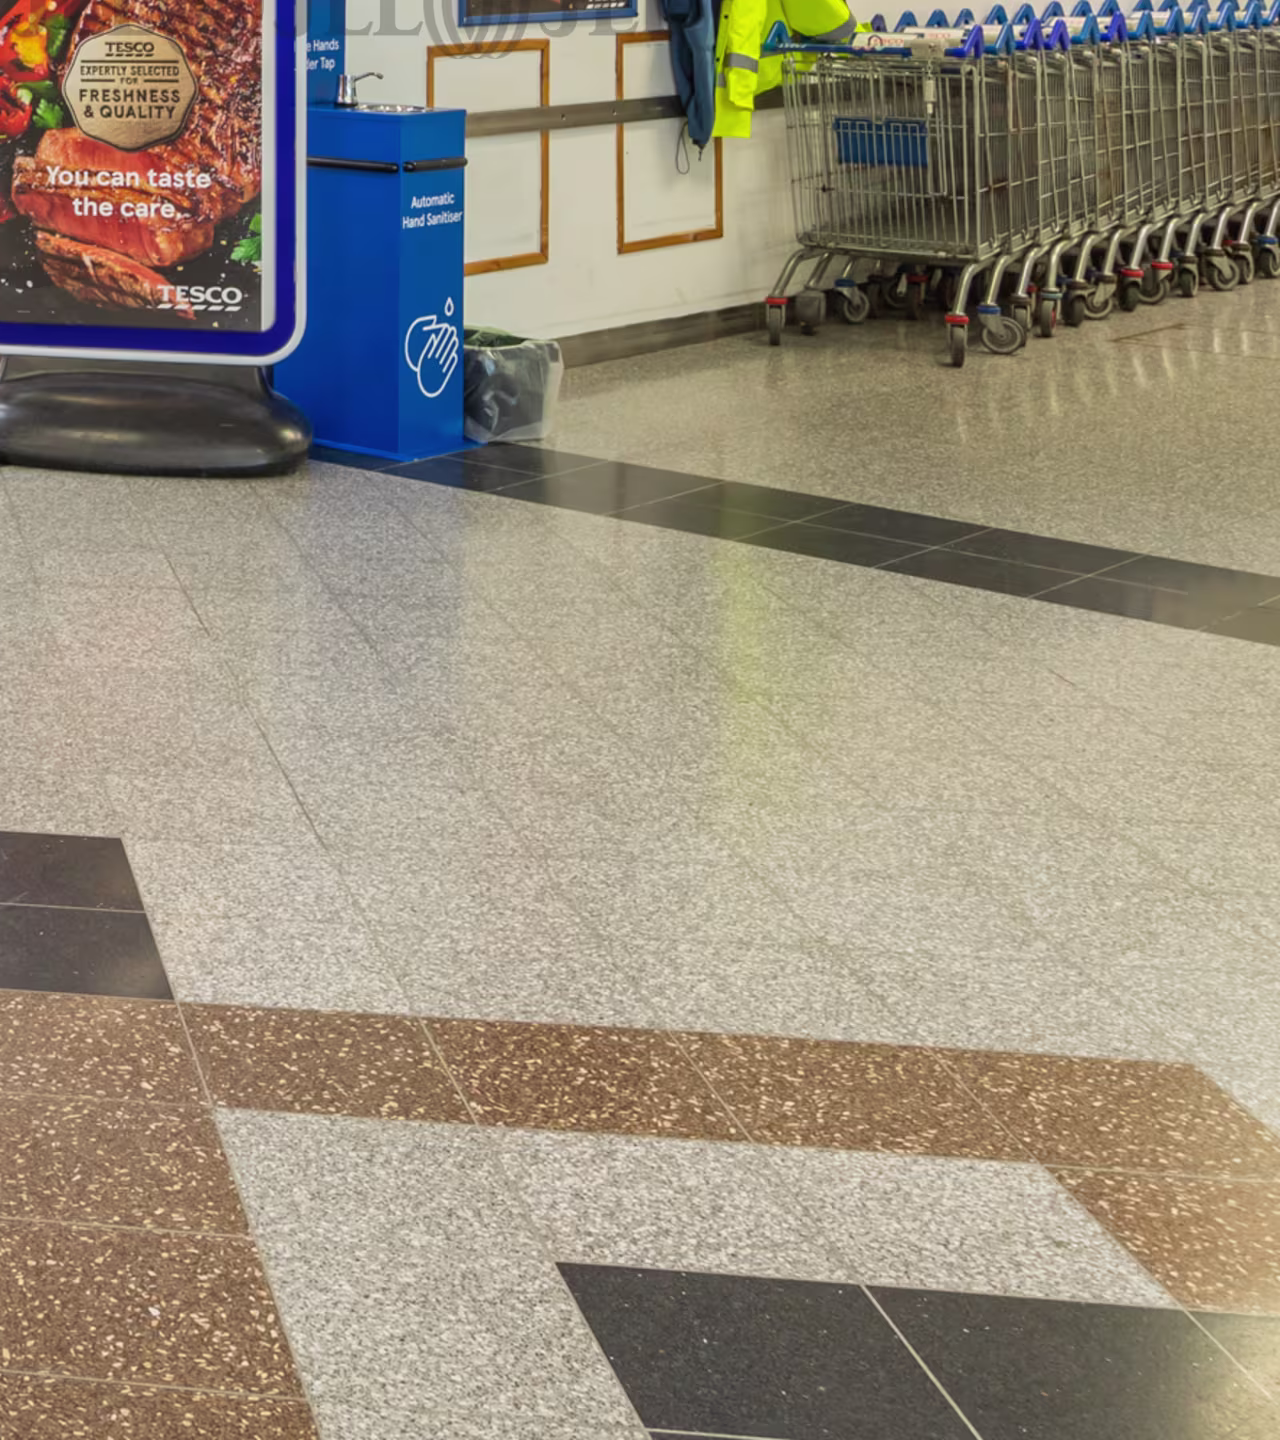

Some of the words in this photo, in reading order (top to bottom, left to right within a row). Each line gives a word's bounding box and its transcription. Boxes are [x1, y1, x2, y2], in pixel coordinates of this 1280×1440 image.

[105, 42, 154, 53] TESCO
[313, 38, 340, 52] Hands
[80, 66, 127, 77] EXPERTLY
[130, 66, 179, 77] SELECTED
[320, 56, 336, 73] Tap
[120, 77, 139, 85] FOR
[79, 88, 181, 103] FRESHNESS
[83, 105, 94, 119] &
[100, 105, 176, 119] QUALITY
[45, 165, 89, 186] You
[96, 171, 139, 187] can
[147, 168, 212, 188] taste
[411, 191, 455, 209] Automatic
[72, 197, 113, 217] the
[120, 203, 183, 220] care.
[402, 214, 425, 230] Hand
[427, 210, 463, 226] Sanitiser
[157, 284, 243, 304] TESCO
